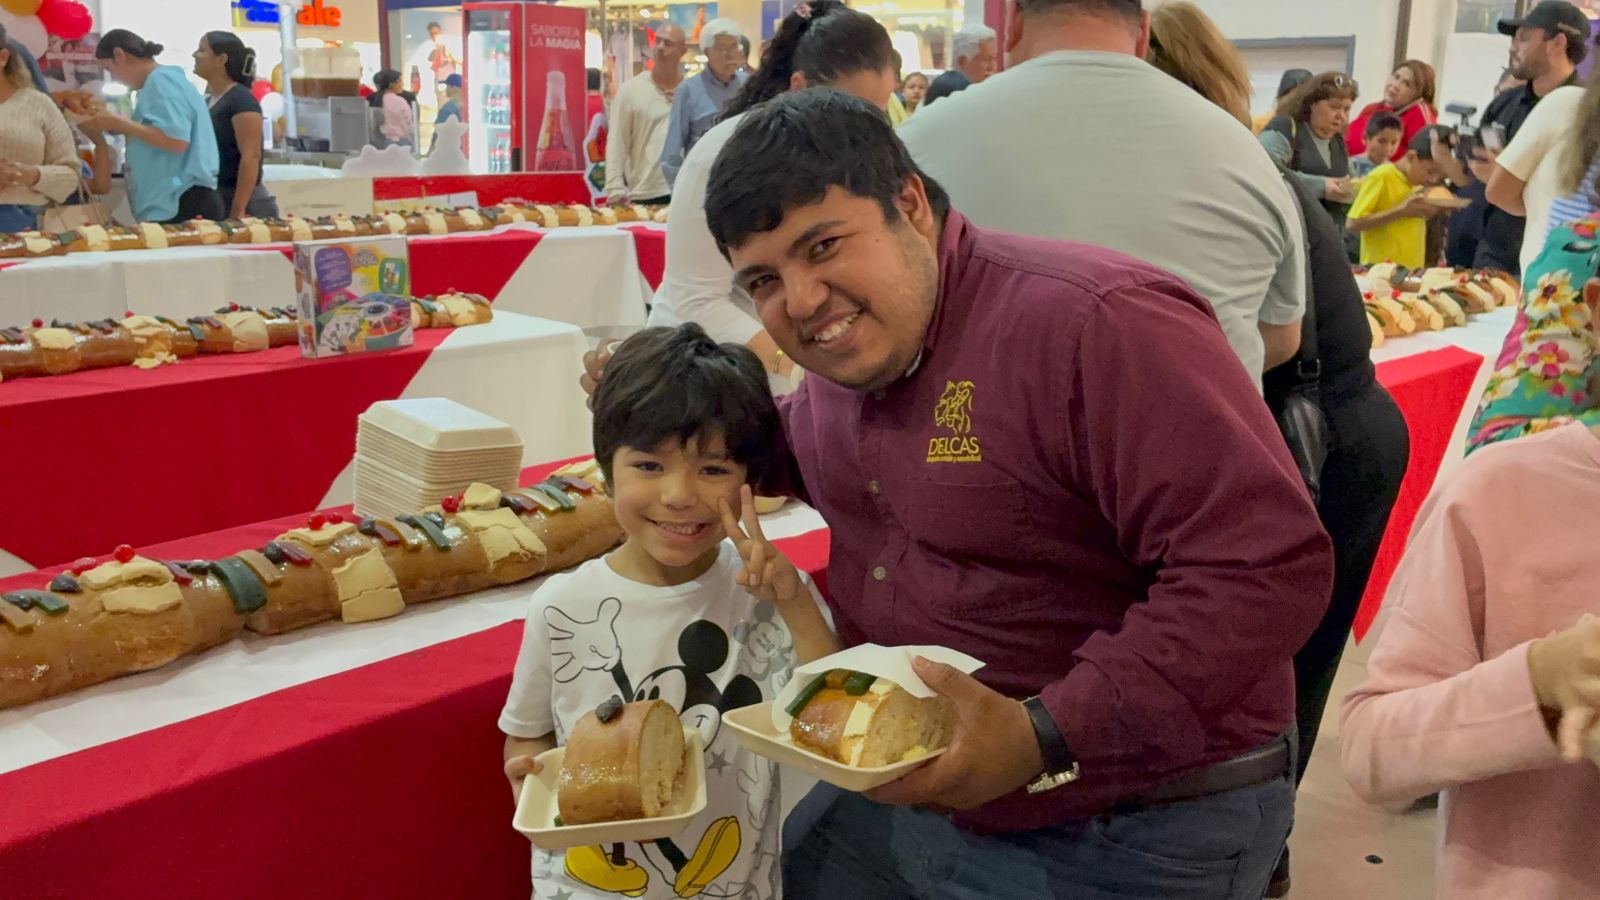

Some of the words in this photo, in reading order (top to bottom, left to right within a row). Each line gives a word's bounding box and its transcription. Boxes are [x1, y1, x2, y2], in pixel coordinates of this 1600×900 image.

[530, 23, 580, 37] SABOREA
[529, 35, 544, 47] LA
[546, 38, 582, 50] MAGIA
[928, 437, 980, 454] DELCAS
